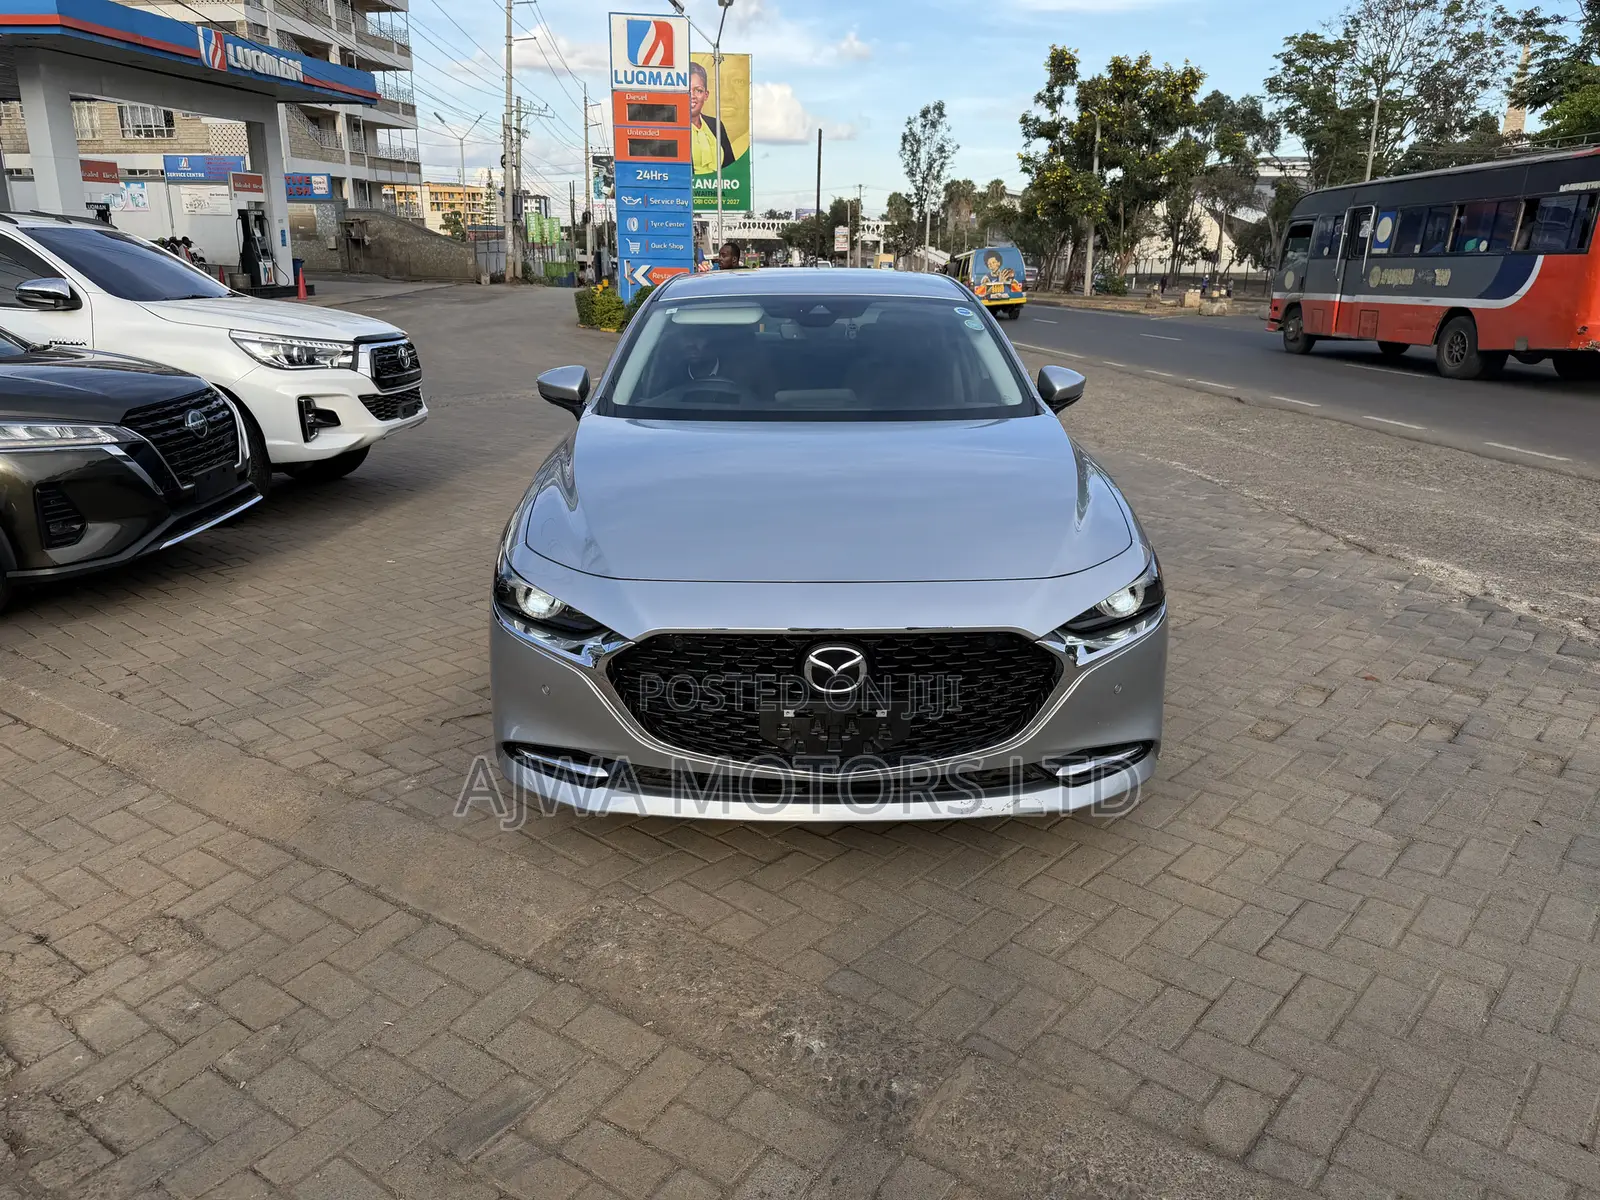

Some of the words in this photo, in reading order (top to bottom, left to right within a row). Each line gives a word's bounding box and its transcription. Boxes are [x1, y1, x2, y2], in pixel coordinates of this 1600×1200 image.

[226, 42, 304, 82] LUQMAN
[614, 69, 688, 87] LUQMAN
[625, 93, 648, 101] Diesel
[627, 128, 660, 137] Unleaded
[635, 169, 669, 181] 24Hrs
[649, 198, 675, 206] Service
[676, 198, 689, 207] Bay
[650, 220, 663, 228] Tyre
[669, 243, 684, 251] Shop
